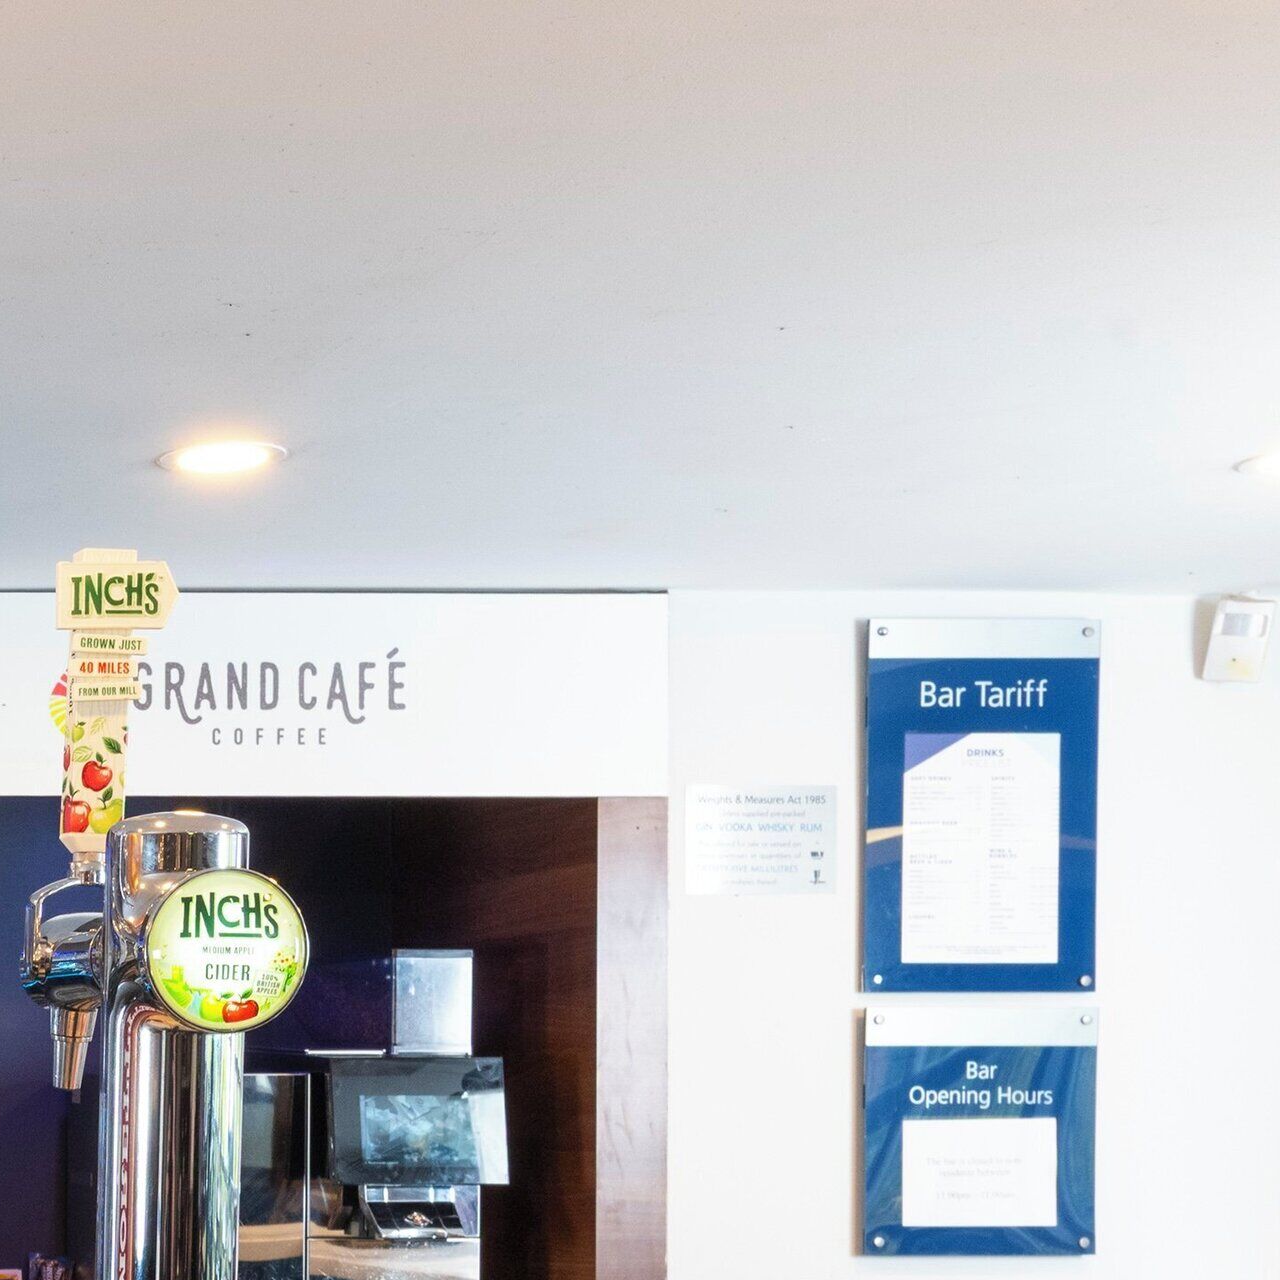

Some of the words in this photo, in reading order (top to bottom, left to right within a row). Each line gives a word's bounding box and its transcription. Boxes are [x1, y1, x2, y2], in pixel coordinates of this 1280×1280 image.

[71, 573, 159, 615] INCH'S
[80, 637, 116, 649] GROWN
[118, 640, 142, 650] JUST
[80, 661, 94, 674] 40
[98, 661, 130, 674] MILES
[79, 687, 99, 697] FROM
[102, 686, 117, 696] OUR
[120, 686, 137, 696] MILL
[132, 661, 279, 725] GRAND
[299, 647, 406, 725] CAFÉ
[919, 680, 966, 708] Bar
[975, 678, 1048, 708] Tariff
[212, 727, 327, 746] COFFEE
[967, 749, 1004, 757] DRINKS
[745, 795, 785, 804] Measures
[787, 795, 801, 804] Act
[805, 795, 826, 804] 1985
[758, 823, 794, 832] WHISKY
[800, 823, 822, 832] RUM
[202, 946, 231, 955] MEDIUM
[205, 964, 250, 981] CIDER
[966, 1060, 998, 1080] Bar
[909, 1085, 991, 1109] Opening
[997, 1086, 1053, 1105] Hours
